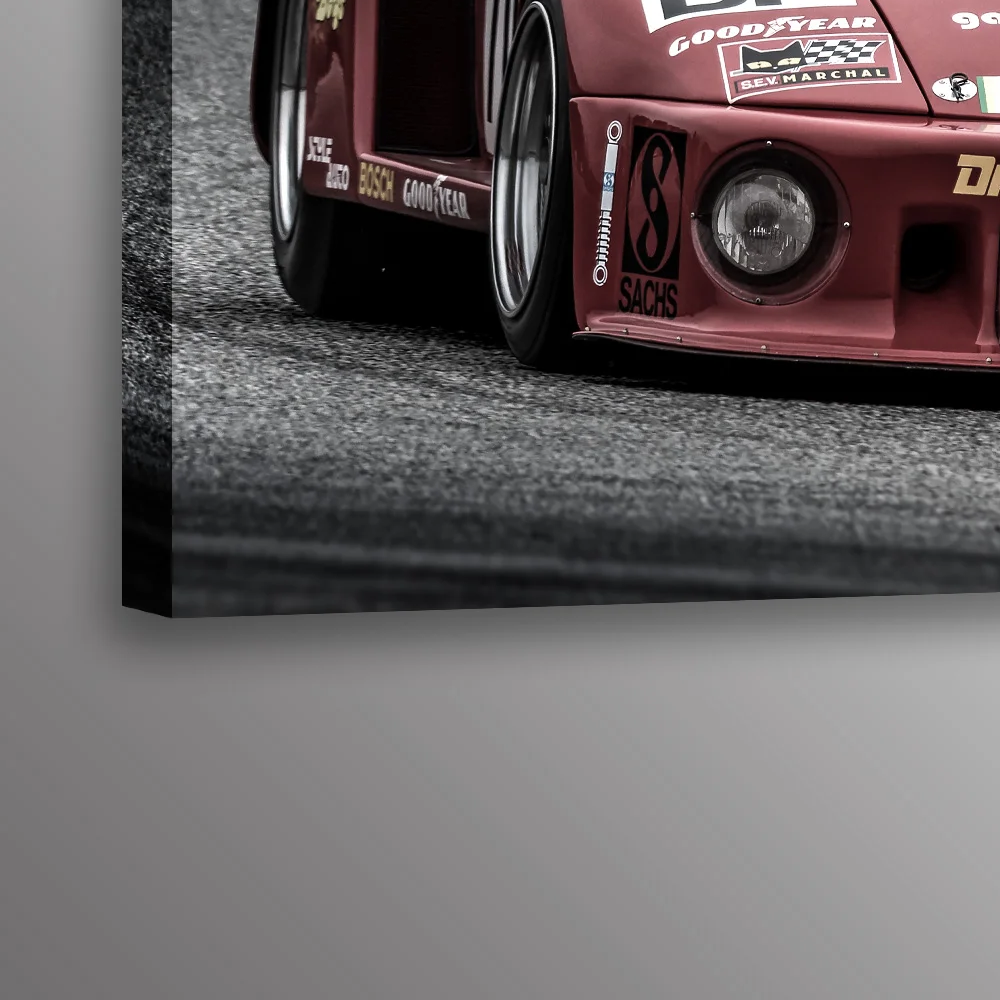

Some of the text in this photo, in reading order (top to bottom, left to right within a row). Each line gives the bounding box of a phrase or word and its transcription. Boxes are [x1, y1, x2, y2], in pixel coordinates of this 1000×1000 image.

[668, 16, 877, 57] GOODYEAR
[782, 68, 887, 84] MARCHAL
[359, 161, 395, 202] BOSCH
[402, 175, 471, 219] GOODYEAR
[618, 276, 678, 319] SACHS
